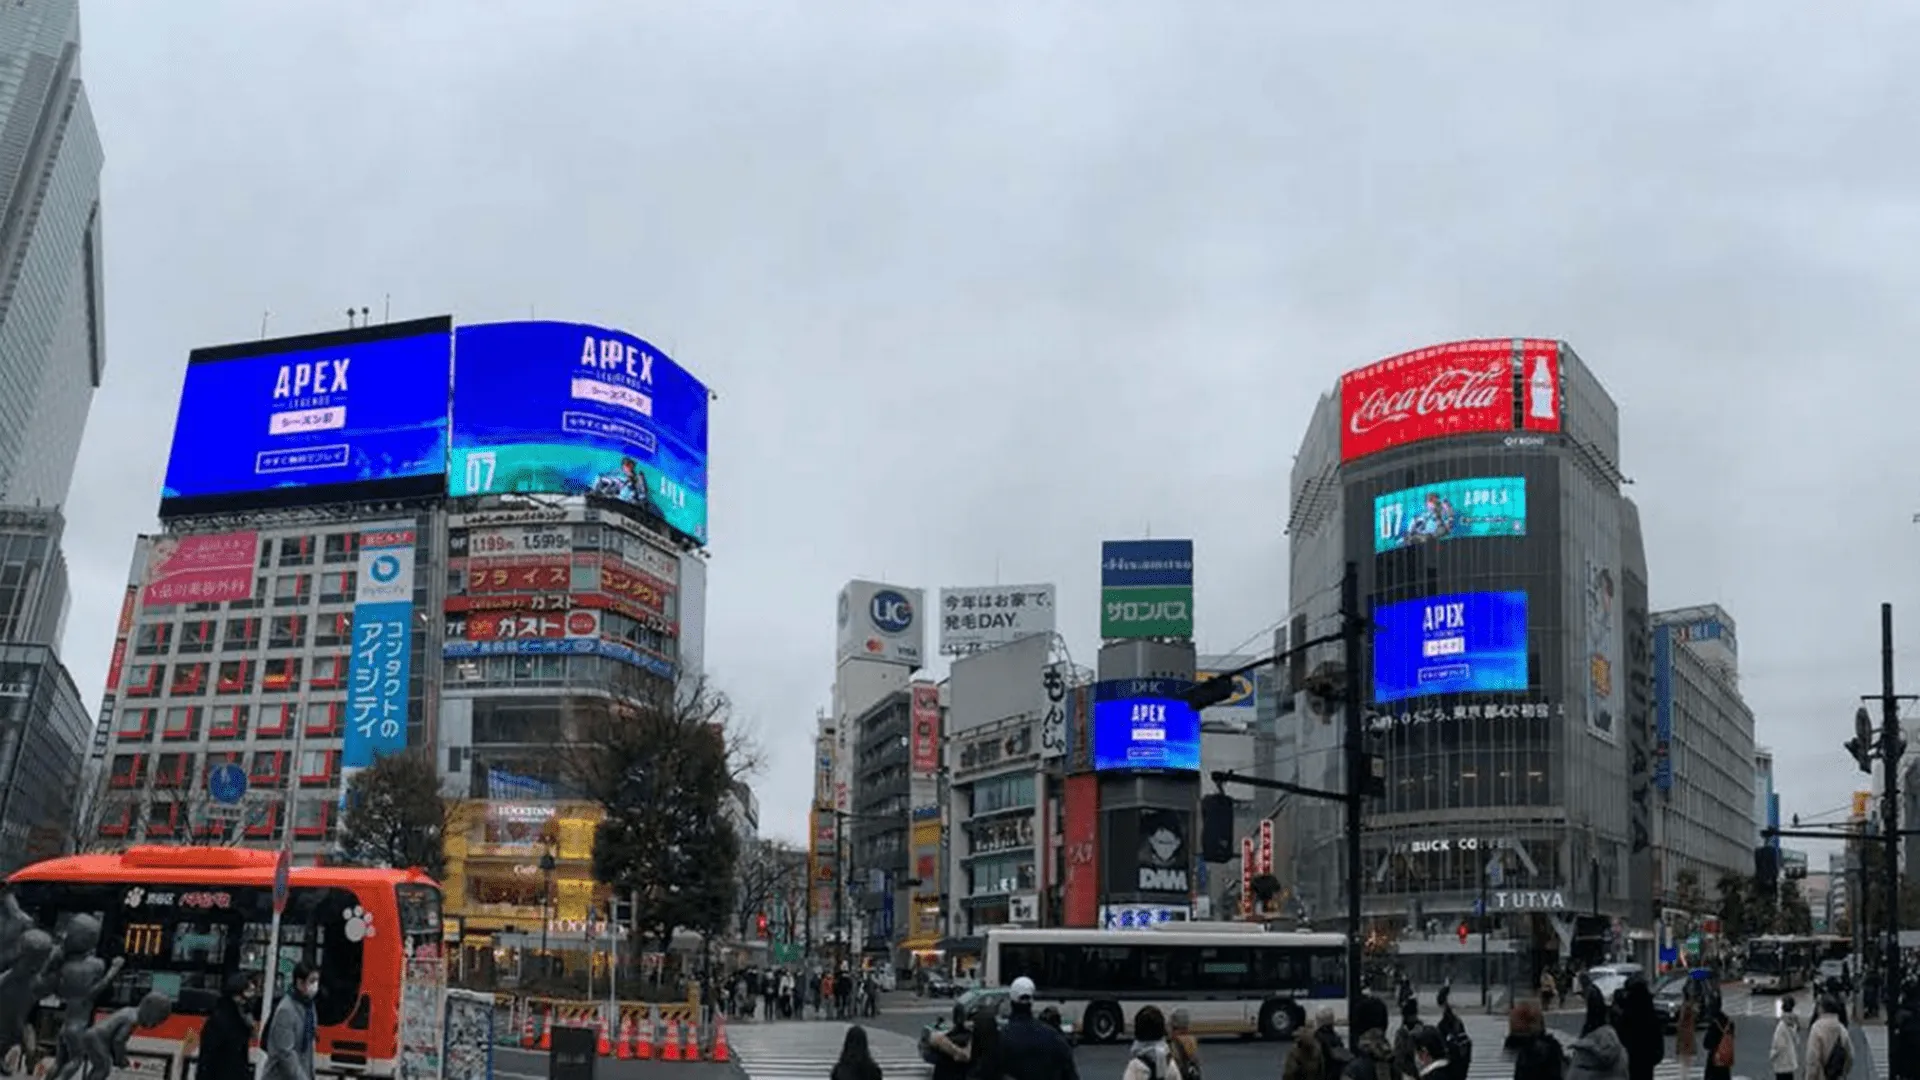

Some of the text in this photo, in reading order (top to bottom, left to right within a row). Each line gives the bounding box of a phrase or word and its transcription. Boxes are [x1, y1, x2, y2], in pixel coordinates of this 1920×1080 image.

[273, 358, 351, 399] APEX
[465, 451, 497, 493] 07
[531, 594, 578, 609] ガスト
[873, 600, 912, 625] UC
[446, 620, 467, 635] 7F
[498, 616, 560, 638] ガスト
[354, 623, 383, 738] アイシティ
[1043, 666, 1065, 753] もんじゃ
[1131, 704, 1166, 722] APEX
